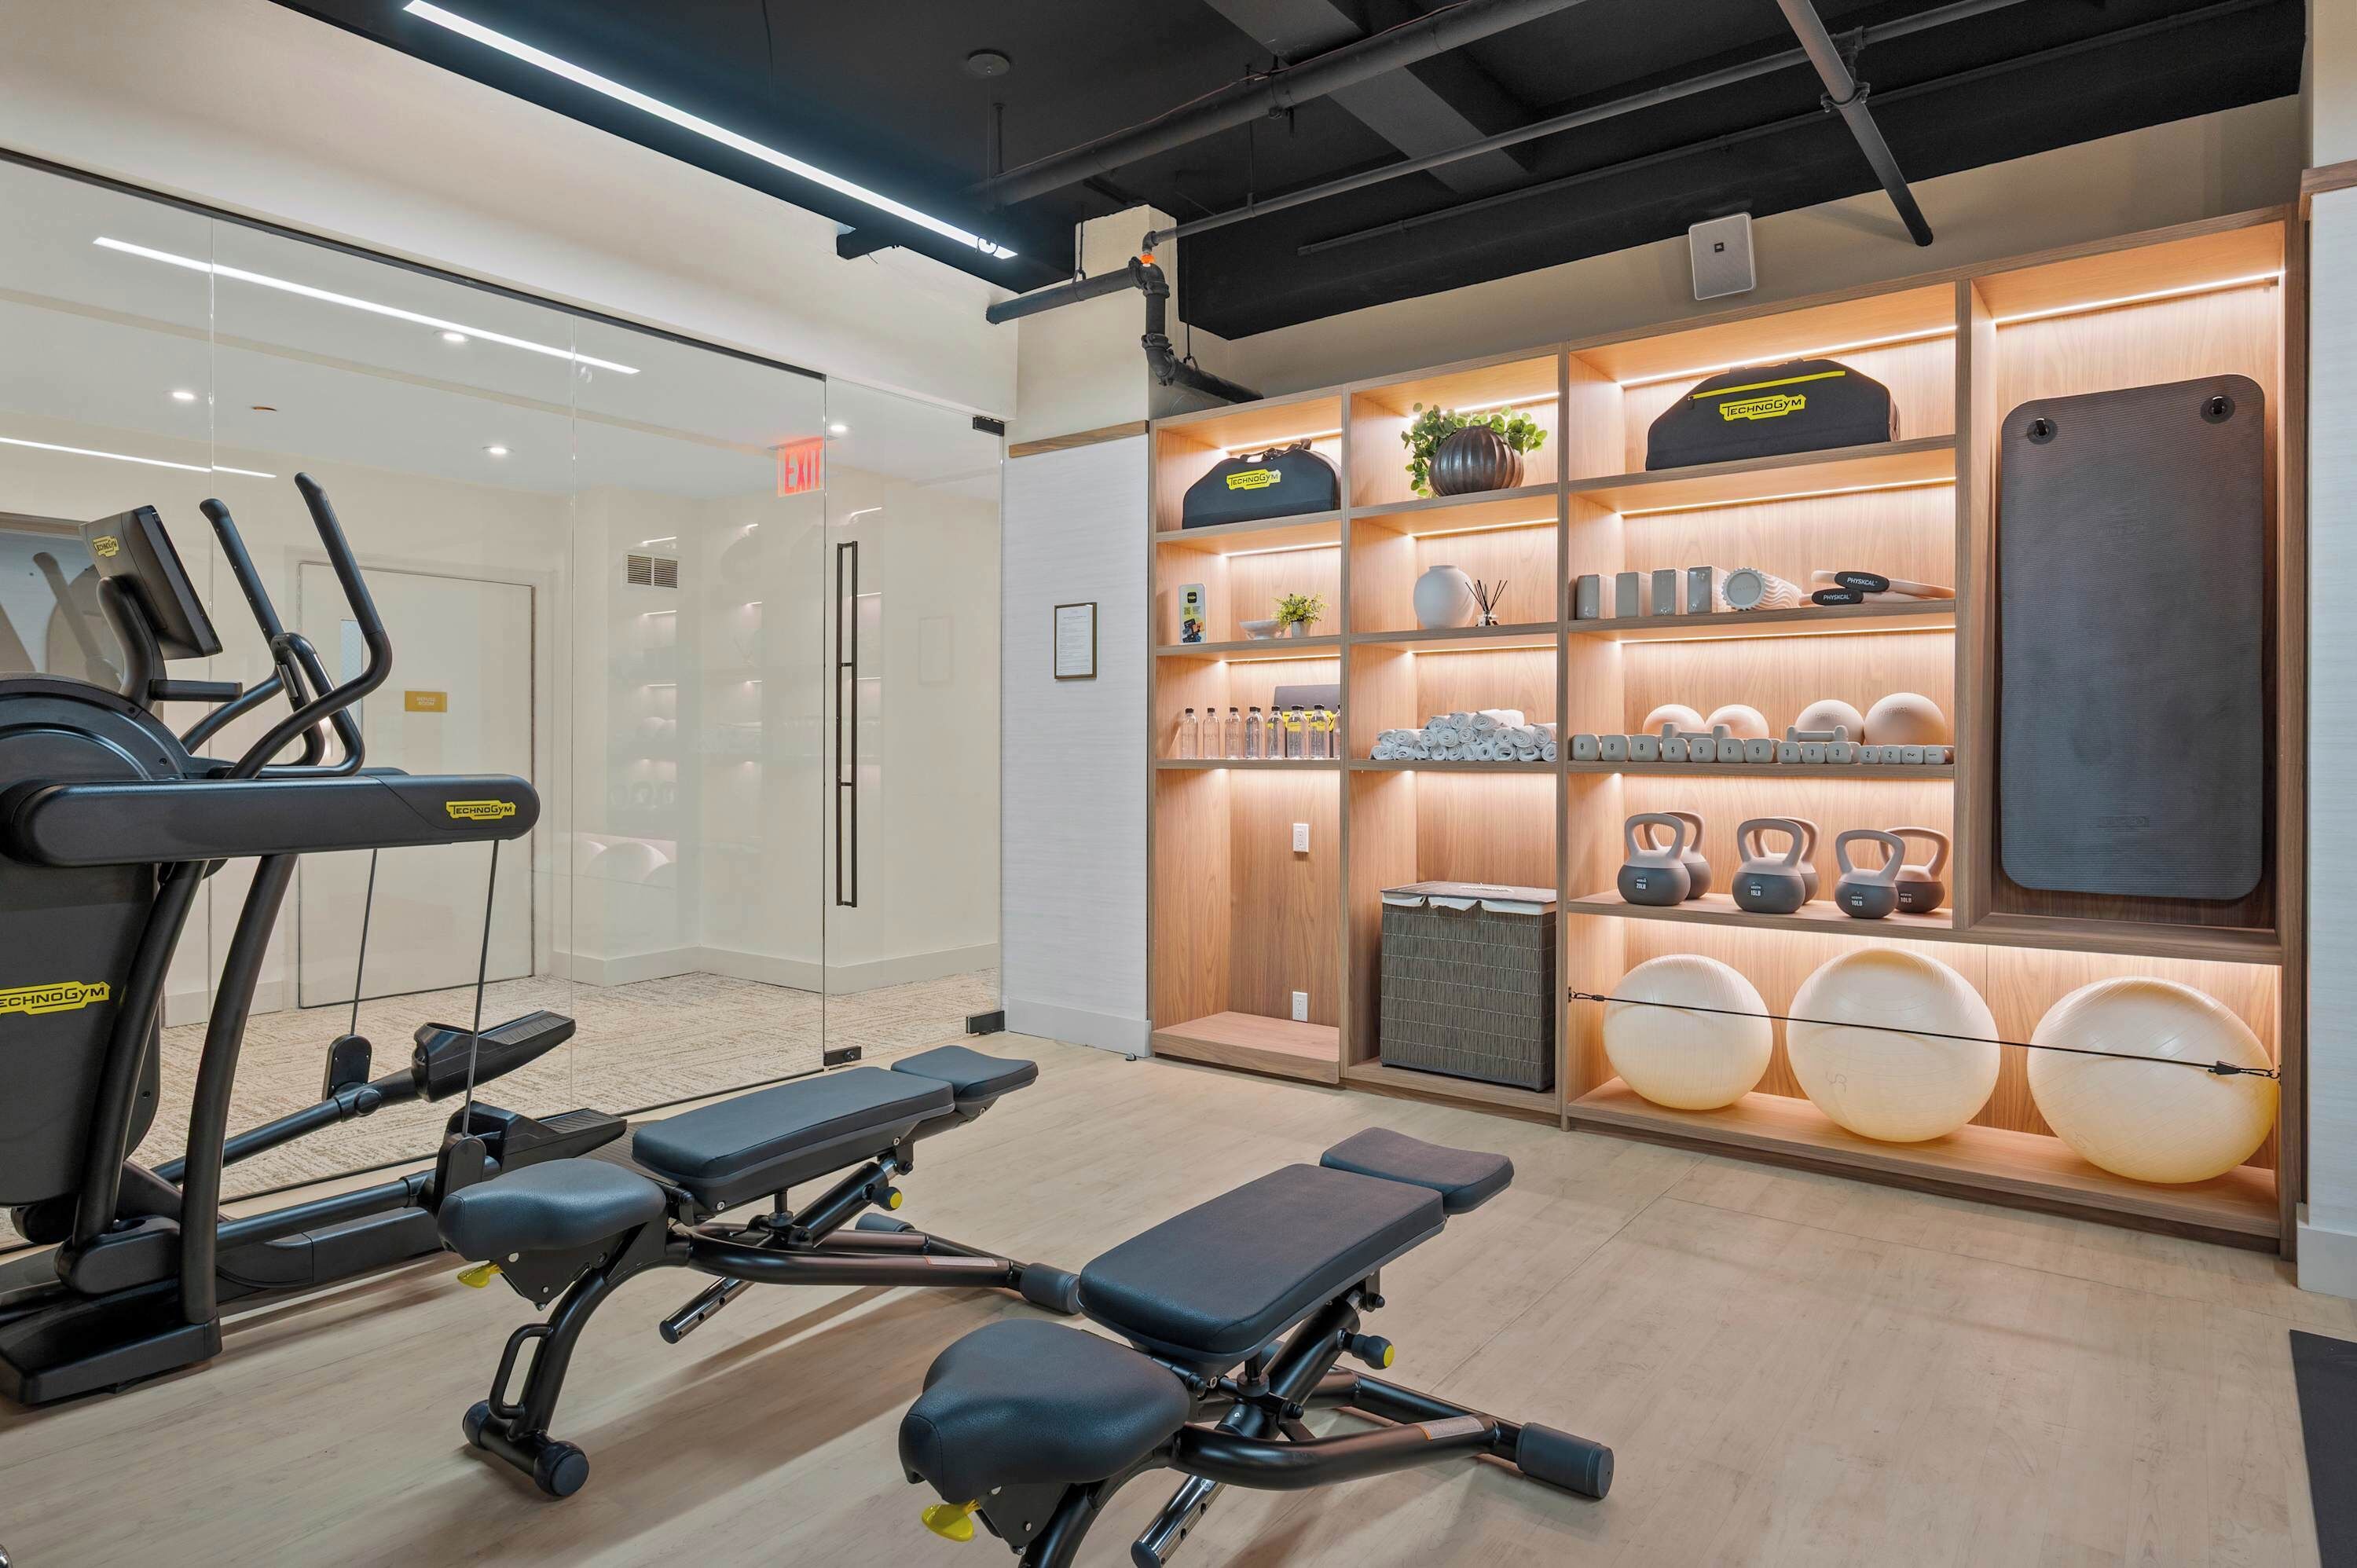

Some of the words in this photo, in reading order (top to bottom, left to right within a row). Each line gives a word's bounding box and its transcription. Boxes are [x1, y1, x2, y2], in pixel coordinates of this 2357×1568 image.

[1722, 398, 1802, 417] TECHNOGYM
[785, 449, 822, 494] EXIT
[449, 804, 513, 816] TECHNOGYM
[0, 987, 104, 1009] ECHNOGYM
